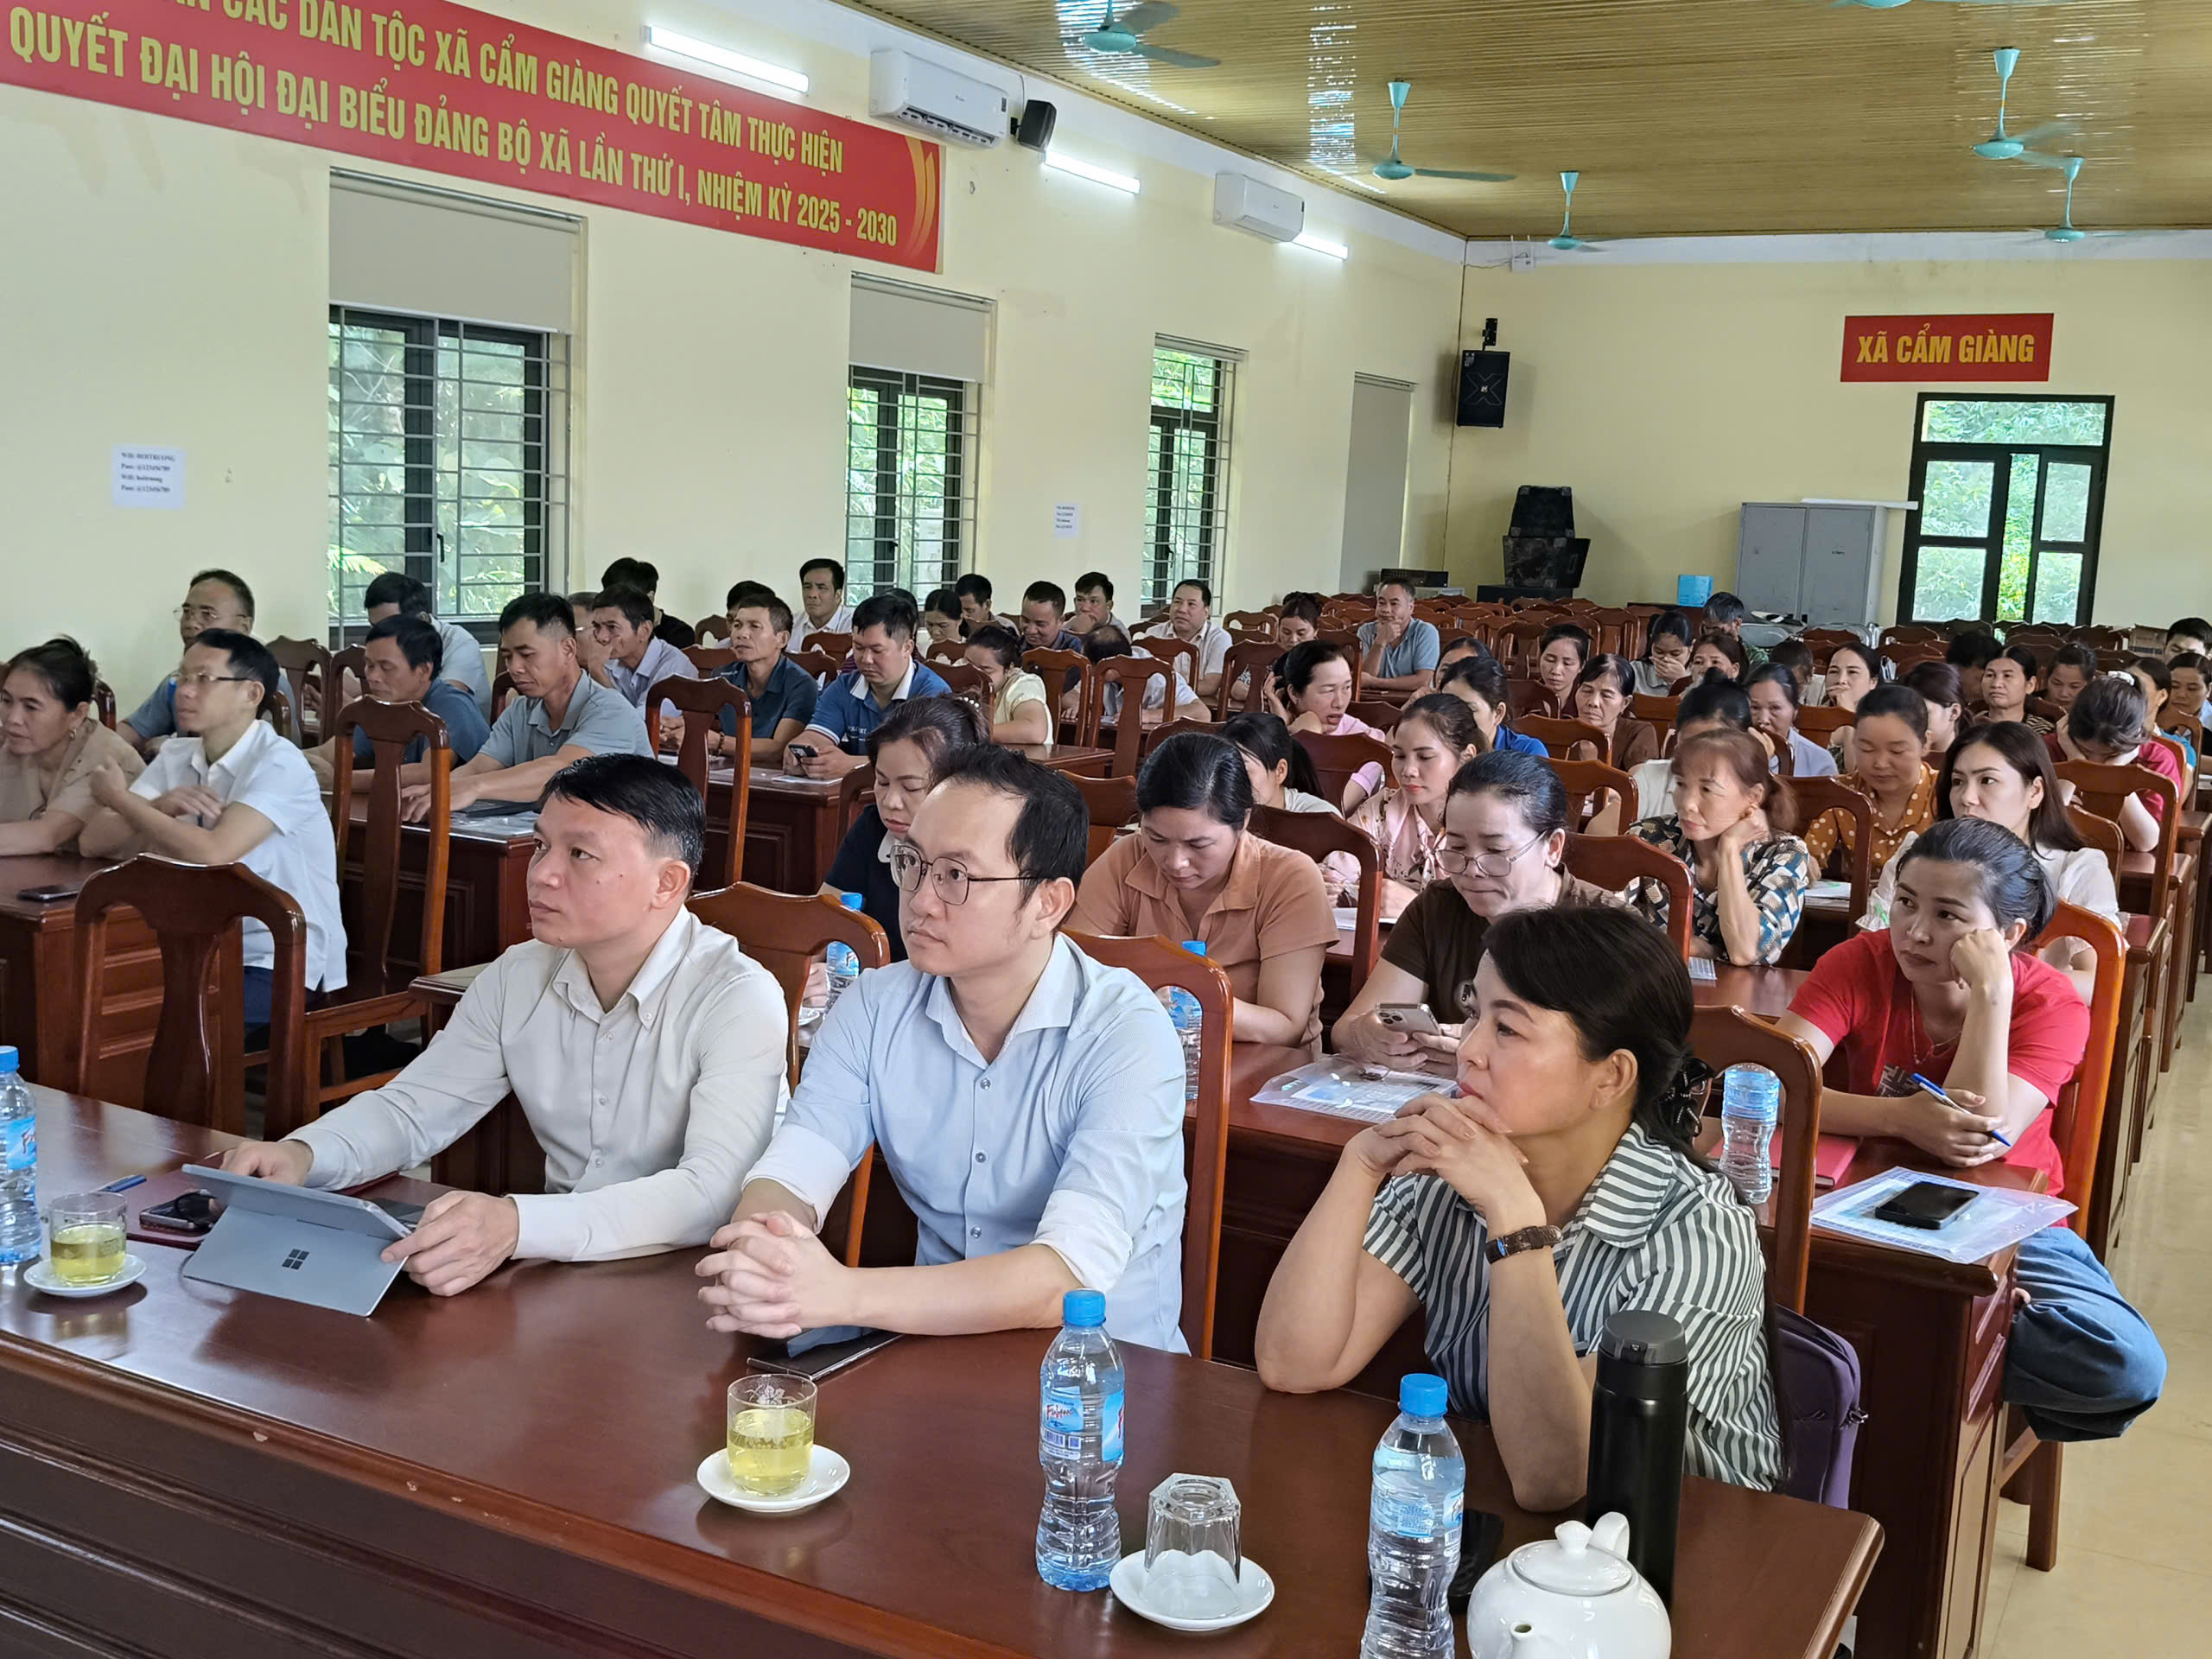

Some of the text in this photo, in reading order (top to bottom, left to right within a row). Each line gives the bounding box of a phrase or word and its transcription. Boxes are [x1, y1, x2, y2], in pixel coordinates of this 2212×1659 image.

[10, 6, 129, 78] QUYẾT
[139, 36, 199, 101] ĐẠI
[211, 50, 265, 115] HỘI
[276, 70, 329, 130] ĐẠI
[340, 77, 406, 140] BIỂU
[414, 93, 489, 157] ĐẢNG
[498, 118, 532, 175] BỘ
[540, 128, 572, 175] XÃ
[580, 130, 623, 187] LẦN
[631, 151, 674, 197] THỨ
[677, 164, 690, 207] I,
[697, 169, 763, 220] NHIỆM
[768, 182, 792, 225] KỲ
[797, 193, 841, 234] 2025
[857, 207, 899, 247] 2030
[372, 10, 426, 71] TỘC
[435, 28, 472, 79] XÃ
[480, 33, 538, 95] CẨM
[546, 59, 619, 115] GIÀNG
[626, 82, 692, 135] QUYẾT
[698, 99, 741, 149] TÂM
[747, 115, 796, 166] THỰC
[801, 129, 843, 177] HIỆN
[1856, 322, 2035, 363] XÃ CẨM GIÀNG
